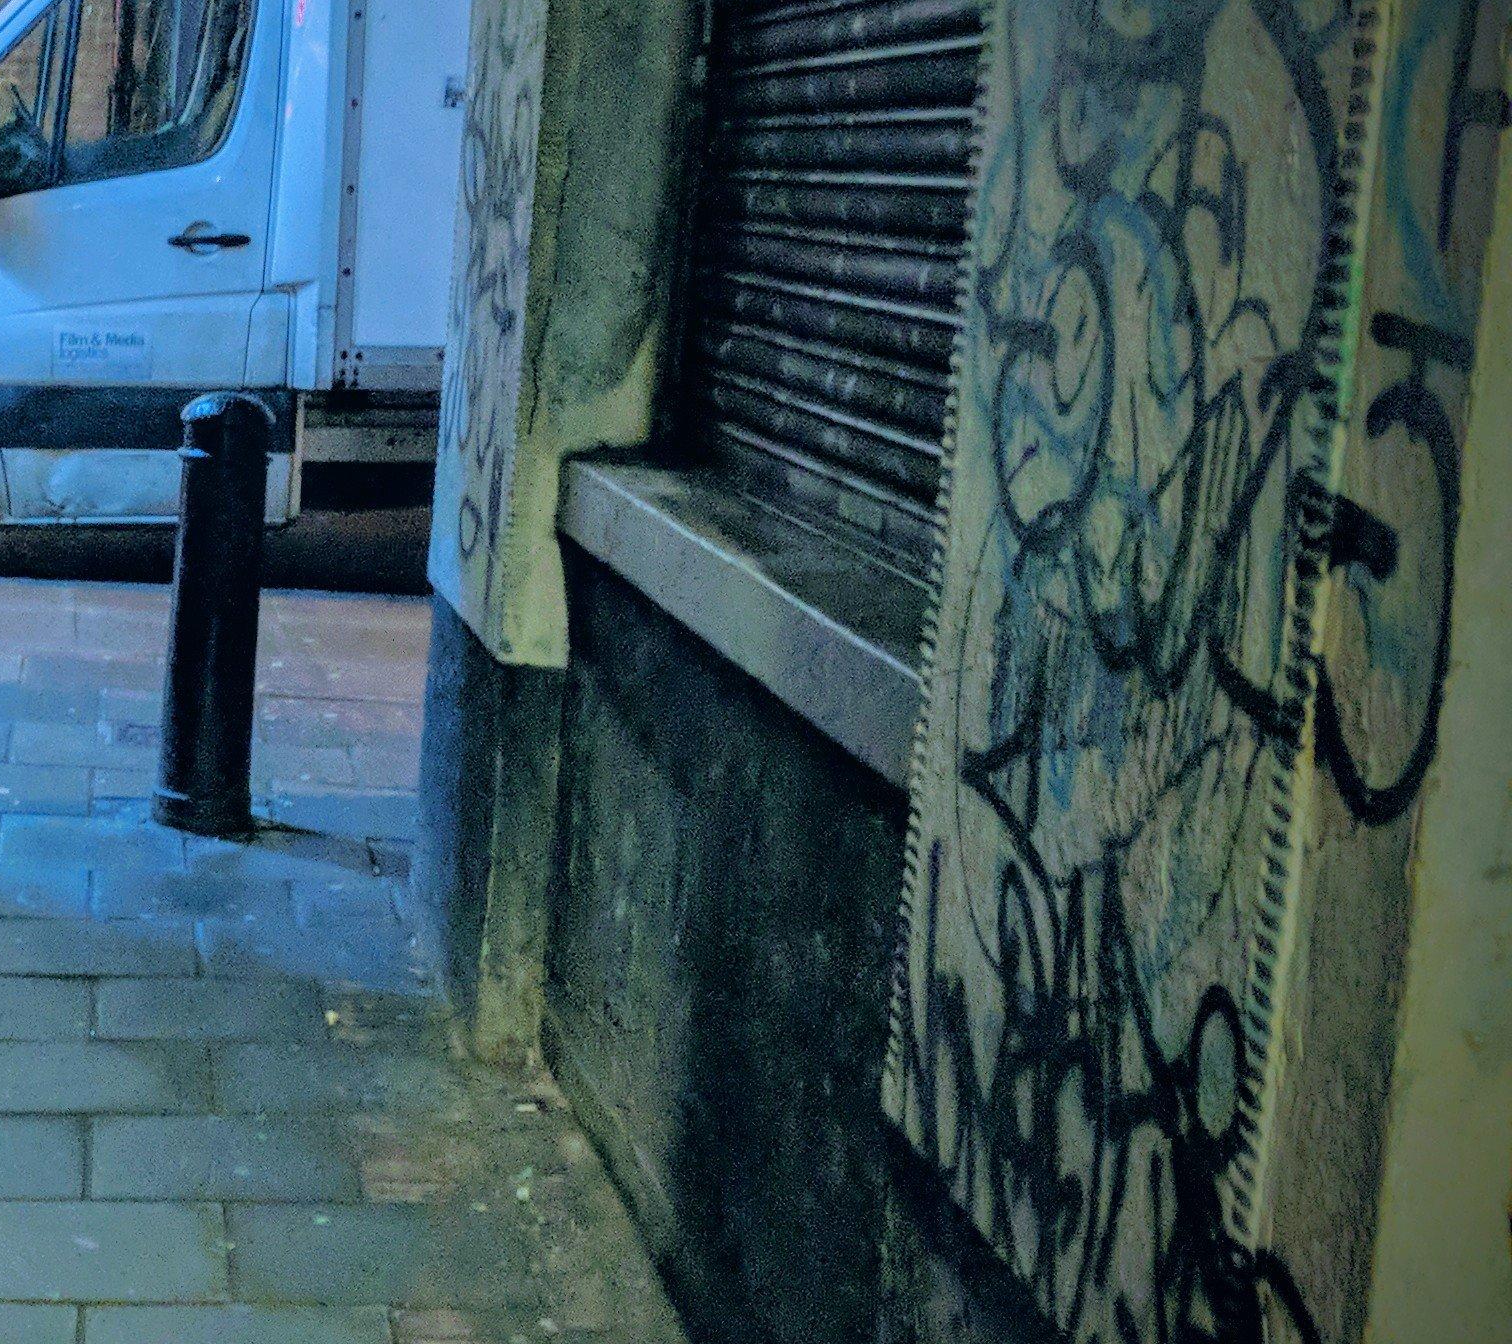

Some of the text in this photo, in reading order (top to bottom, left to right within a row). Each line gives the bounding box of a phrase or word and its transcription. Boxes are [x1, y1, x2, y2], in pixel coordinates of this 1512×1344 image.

[59, 332, 145, 347] Film & Media
